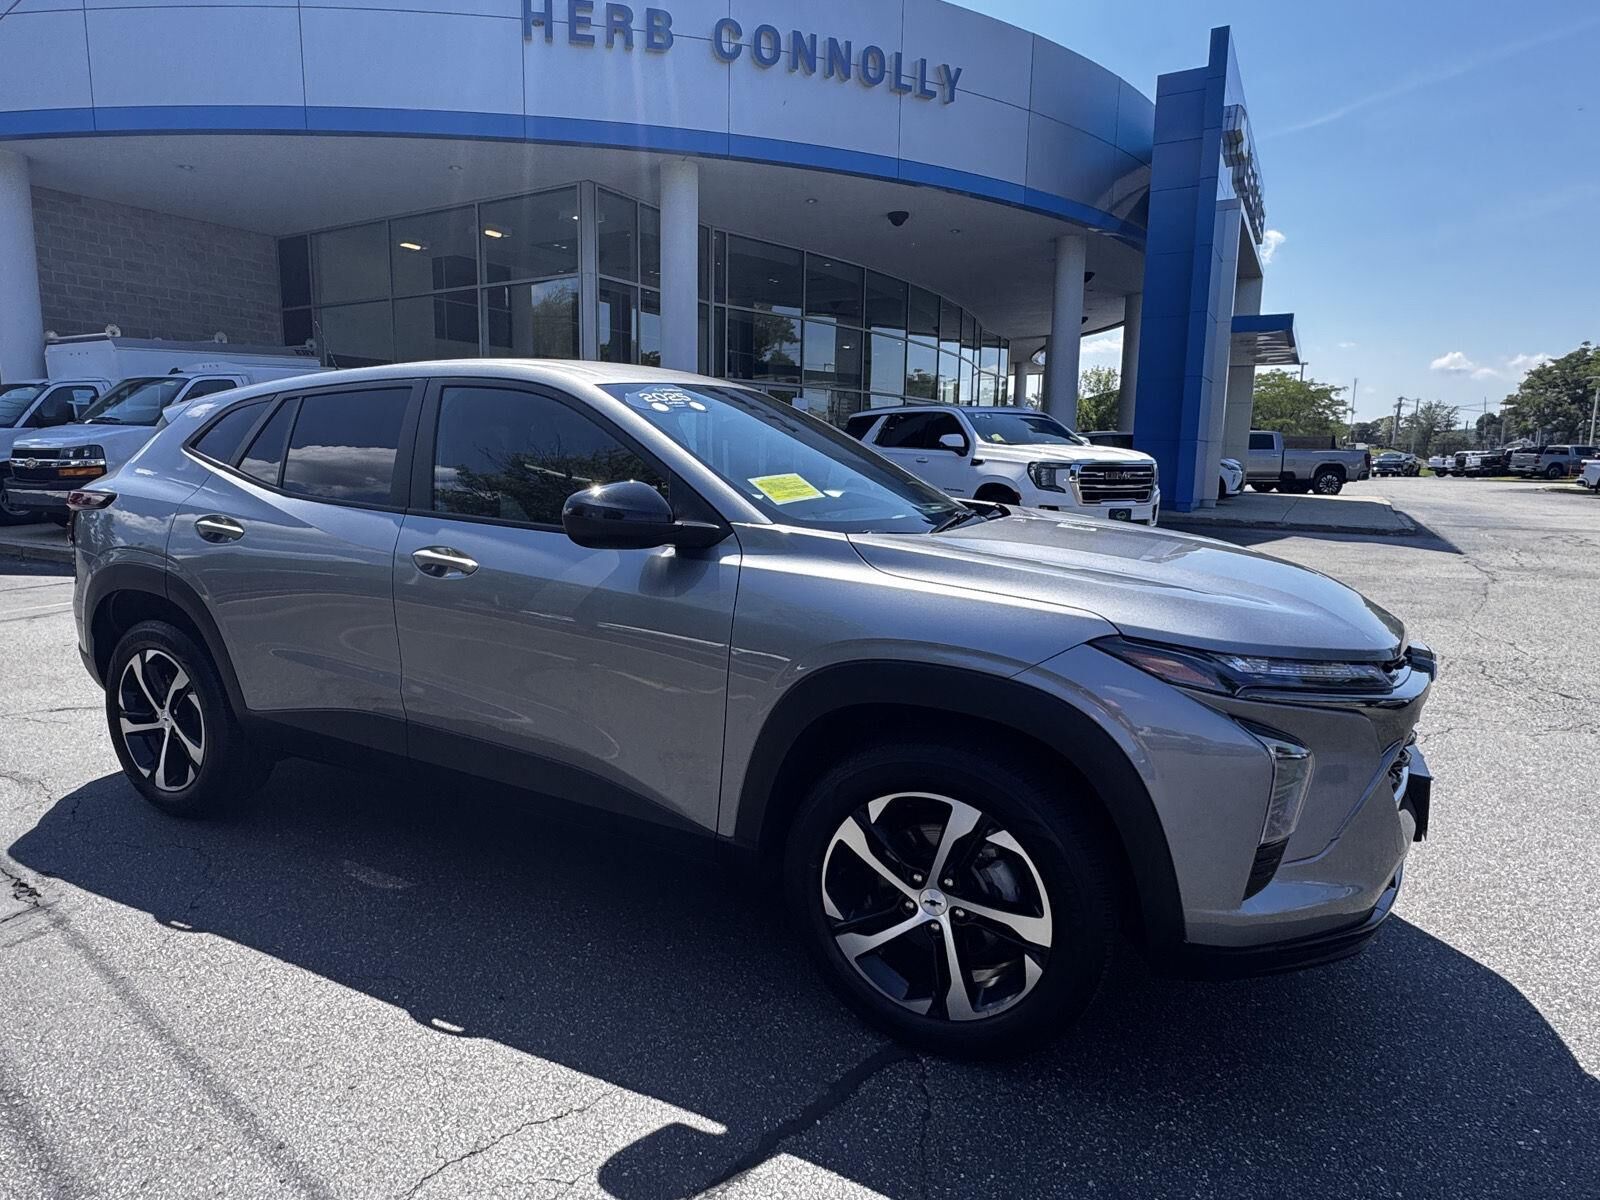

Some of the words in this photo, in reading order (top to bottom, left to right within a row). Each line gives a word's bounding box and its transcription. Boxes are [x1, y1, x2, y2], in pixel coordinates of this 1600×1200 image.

[523, 0, 674, 52] HERB
[713, 17, 962, 104] CONNOLLY
[639, 392, 692, 402] 2025
